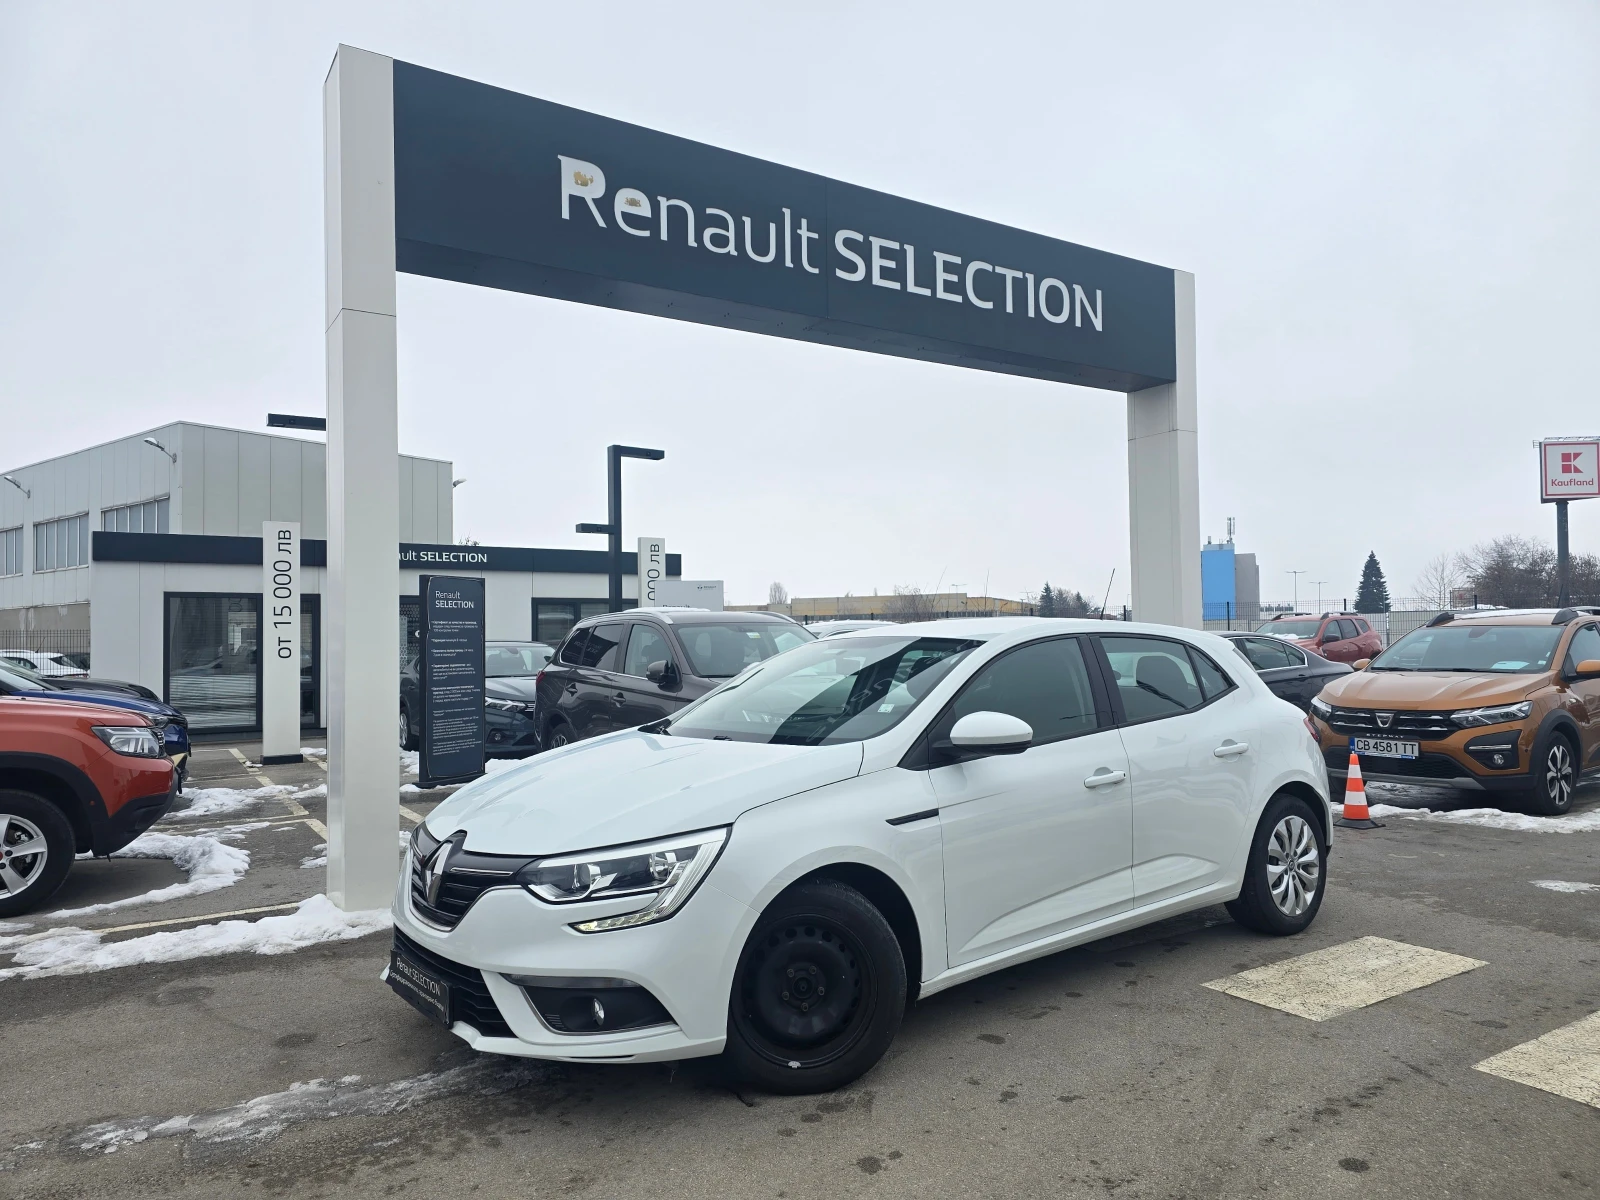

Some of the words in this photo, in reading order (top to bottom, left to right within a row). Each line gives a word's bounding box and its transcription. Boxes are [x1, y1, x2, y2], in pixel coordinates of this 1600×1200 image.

[557, 154, 820, 274] Renault
[834, 229, 1103, 332] SELECTION
[1551, 478, 1594, 487] Kaufland
[420, 551, 488, 563] SELECTION
[273, 560, 292, 599] 000
[435, 590, 460, 600] Renault
[435, 600, 474, 608] SELECTION
[273, 606, 292, 629] 15
[277, 637, 292, 659] от
[1356, 739, 1371, 751] CB
[1372, 741, 1399, 754] 4581
[1401, 743, 1417, 755] TT
[413, 968, 441, 996] SELECTION
